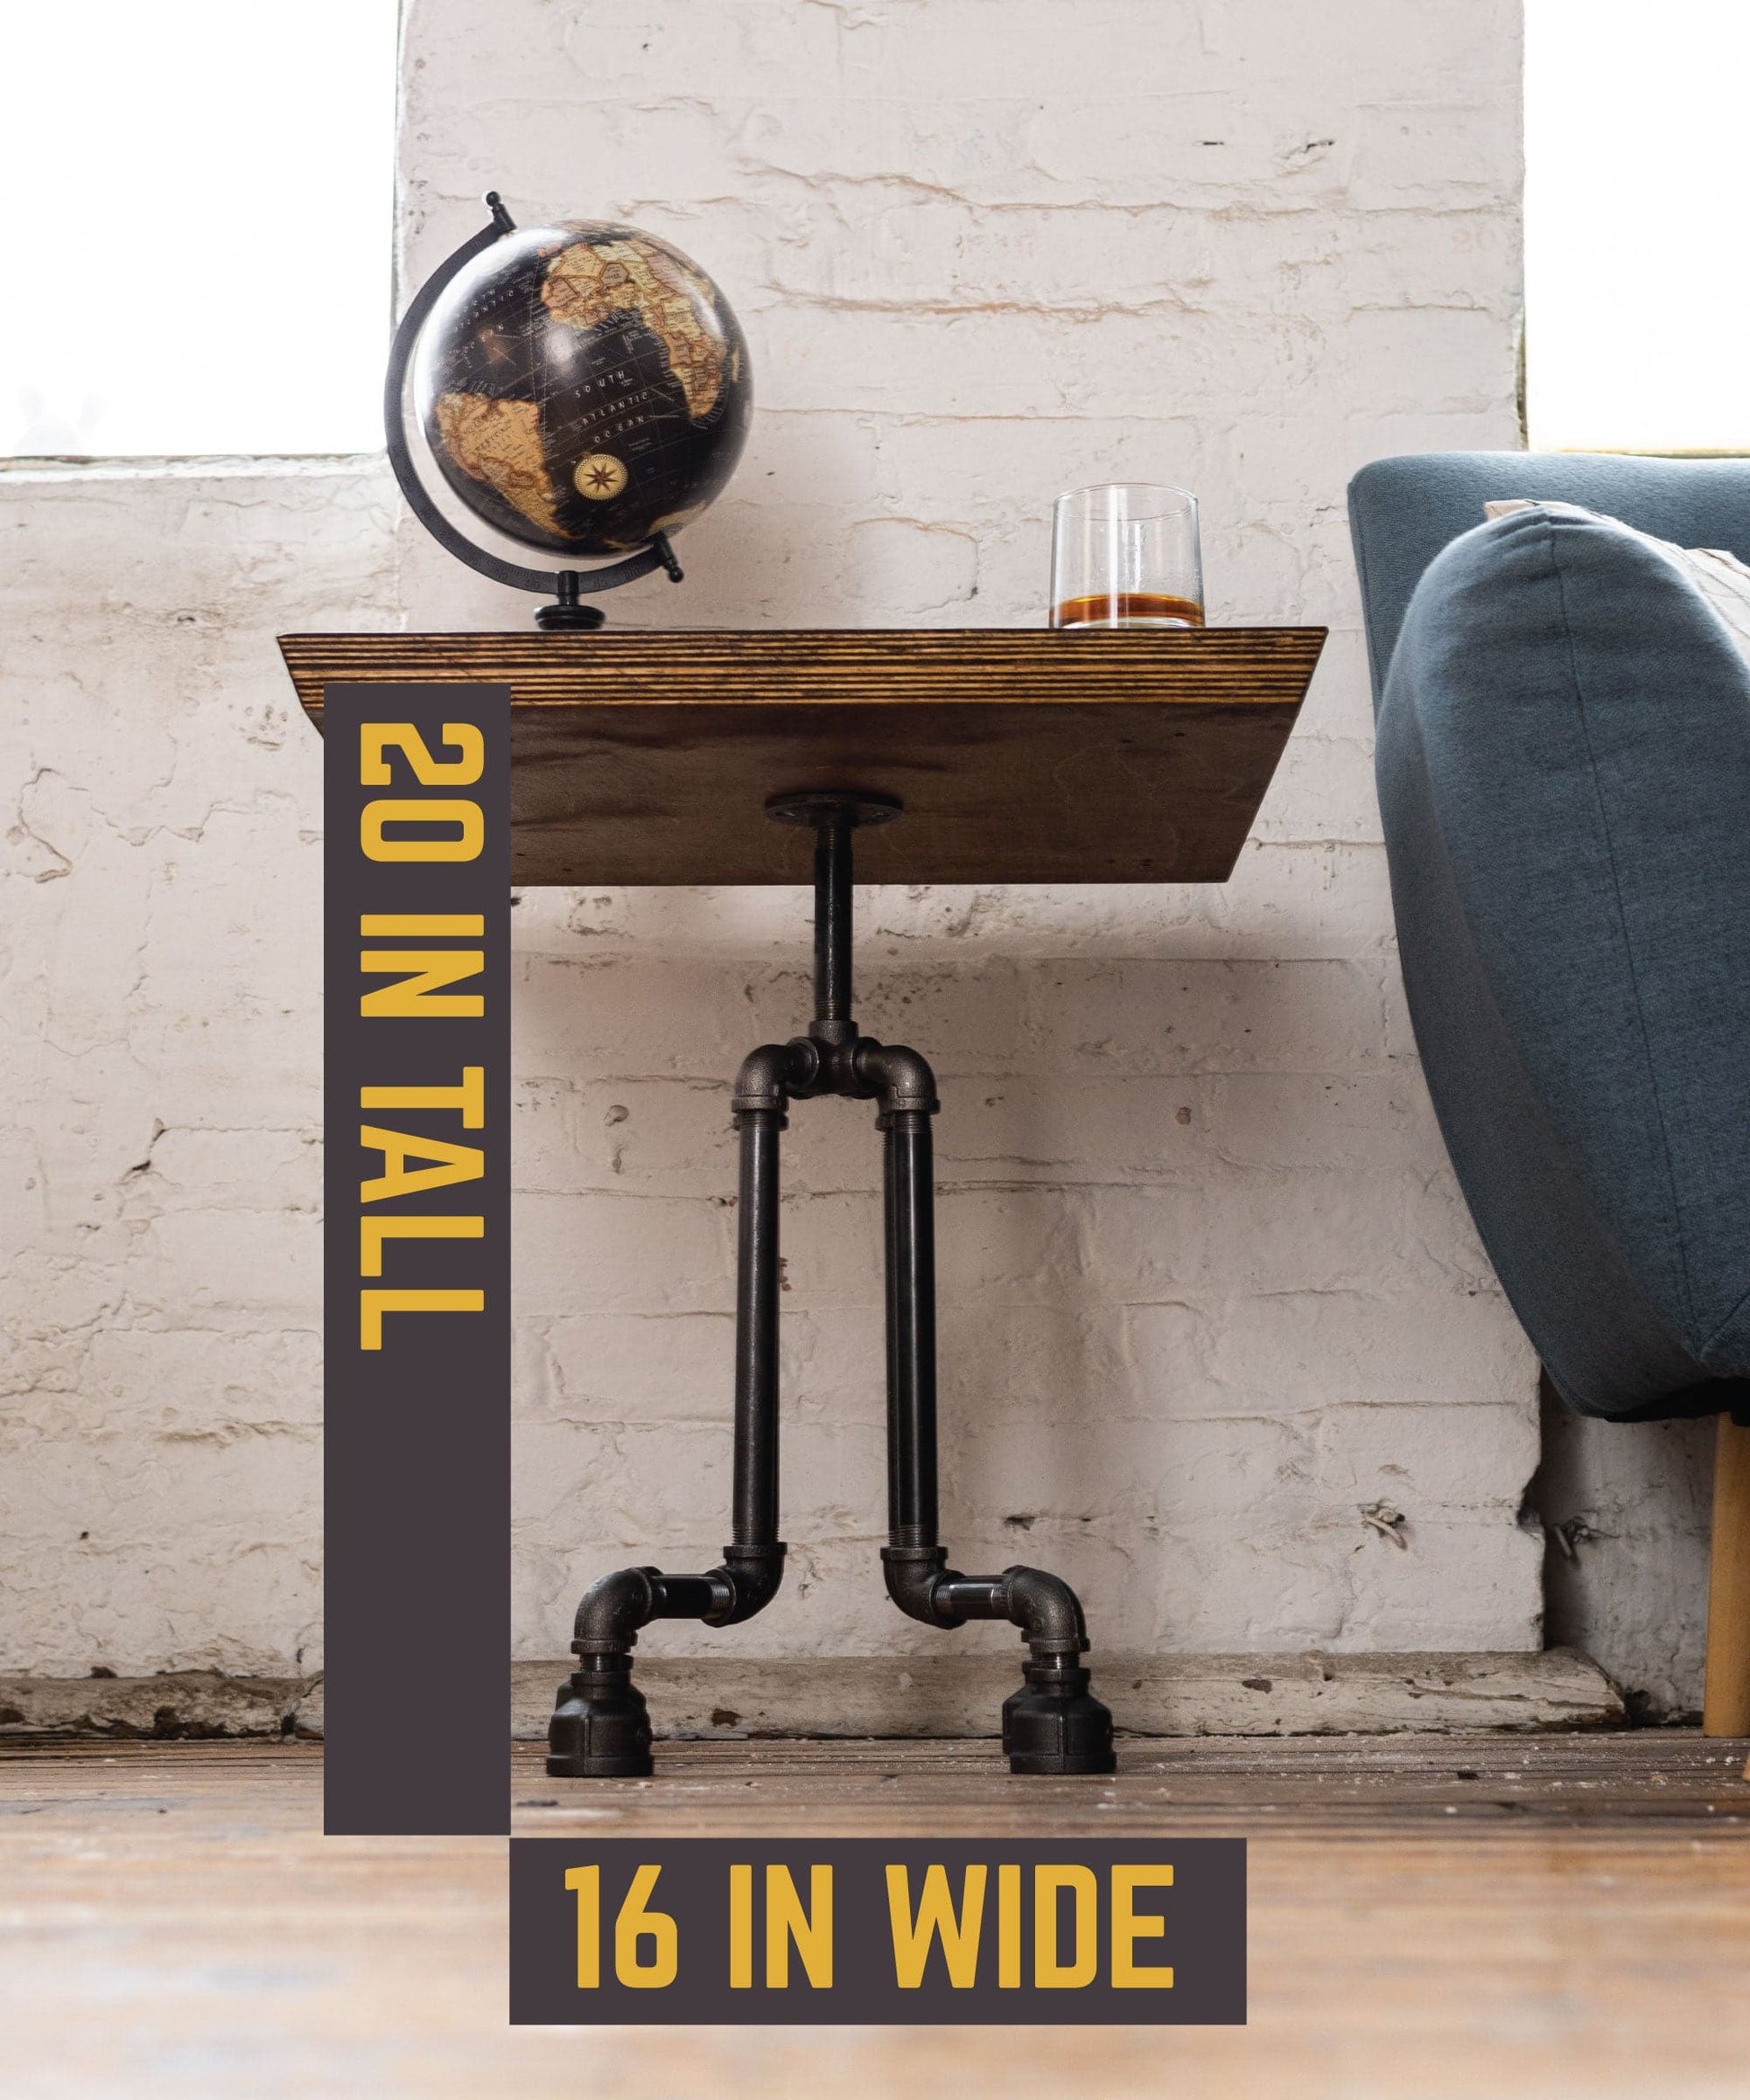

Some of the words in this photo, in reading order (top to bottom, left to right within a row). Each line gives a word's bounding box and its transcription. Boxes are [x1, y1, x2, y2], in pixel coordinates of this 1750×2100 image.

[575, 370, 626, 398] SOUTH
[581, 391, 648, 426] ATLANTIC
[594, 415, 645, 443] OCEAN
